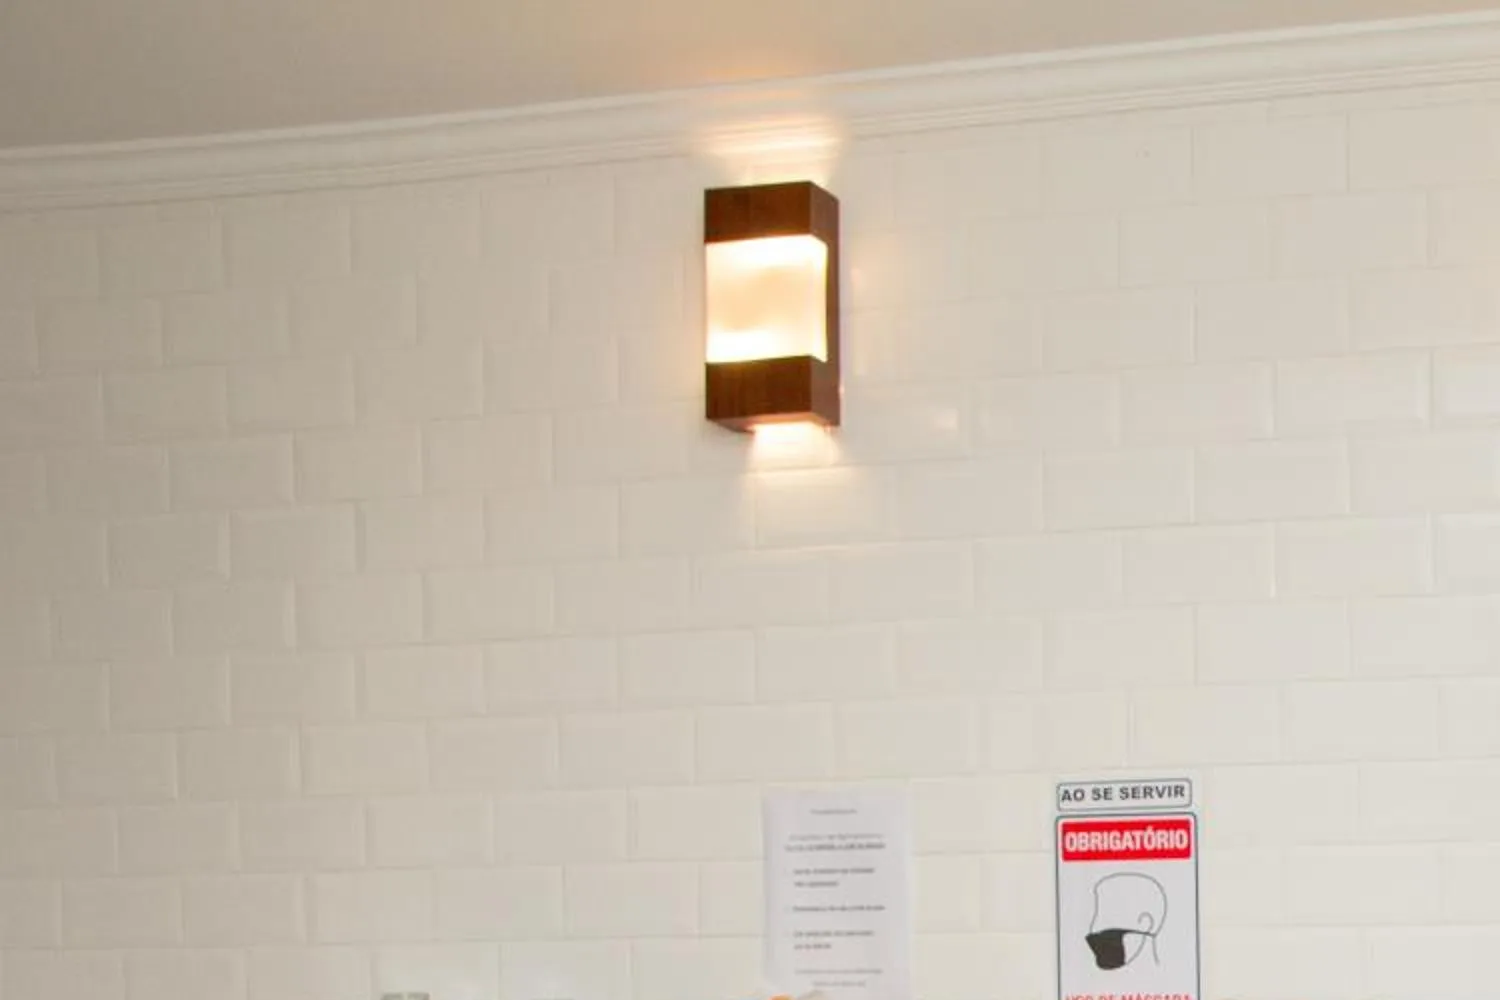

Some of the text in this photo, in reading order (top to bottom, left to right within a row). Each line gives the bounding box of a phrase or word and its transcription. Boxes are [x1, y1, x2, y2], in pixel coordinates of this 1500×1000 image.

[1061, 785, 1185, 802] AO SE SERVIR
[1065, 825, 1189, 853] OBRIGATÓRIO
